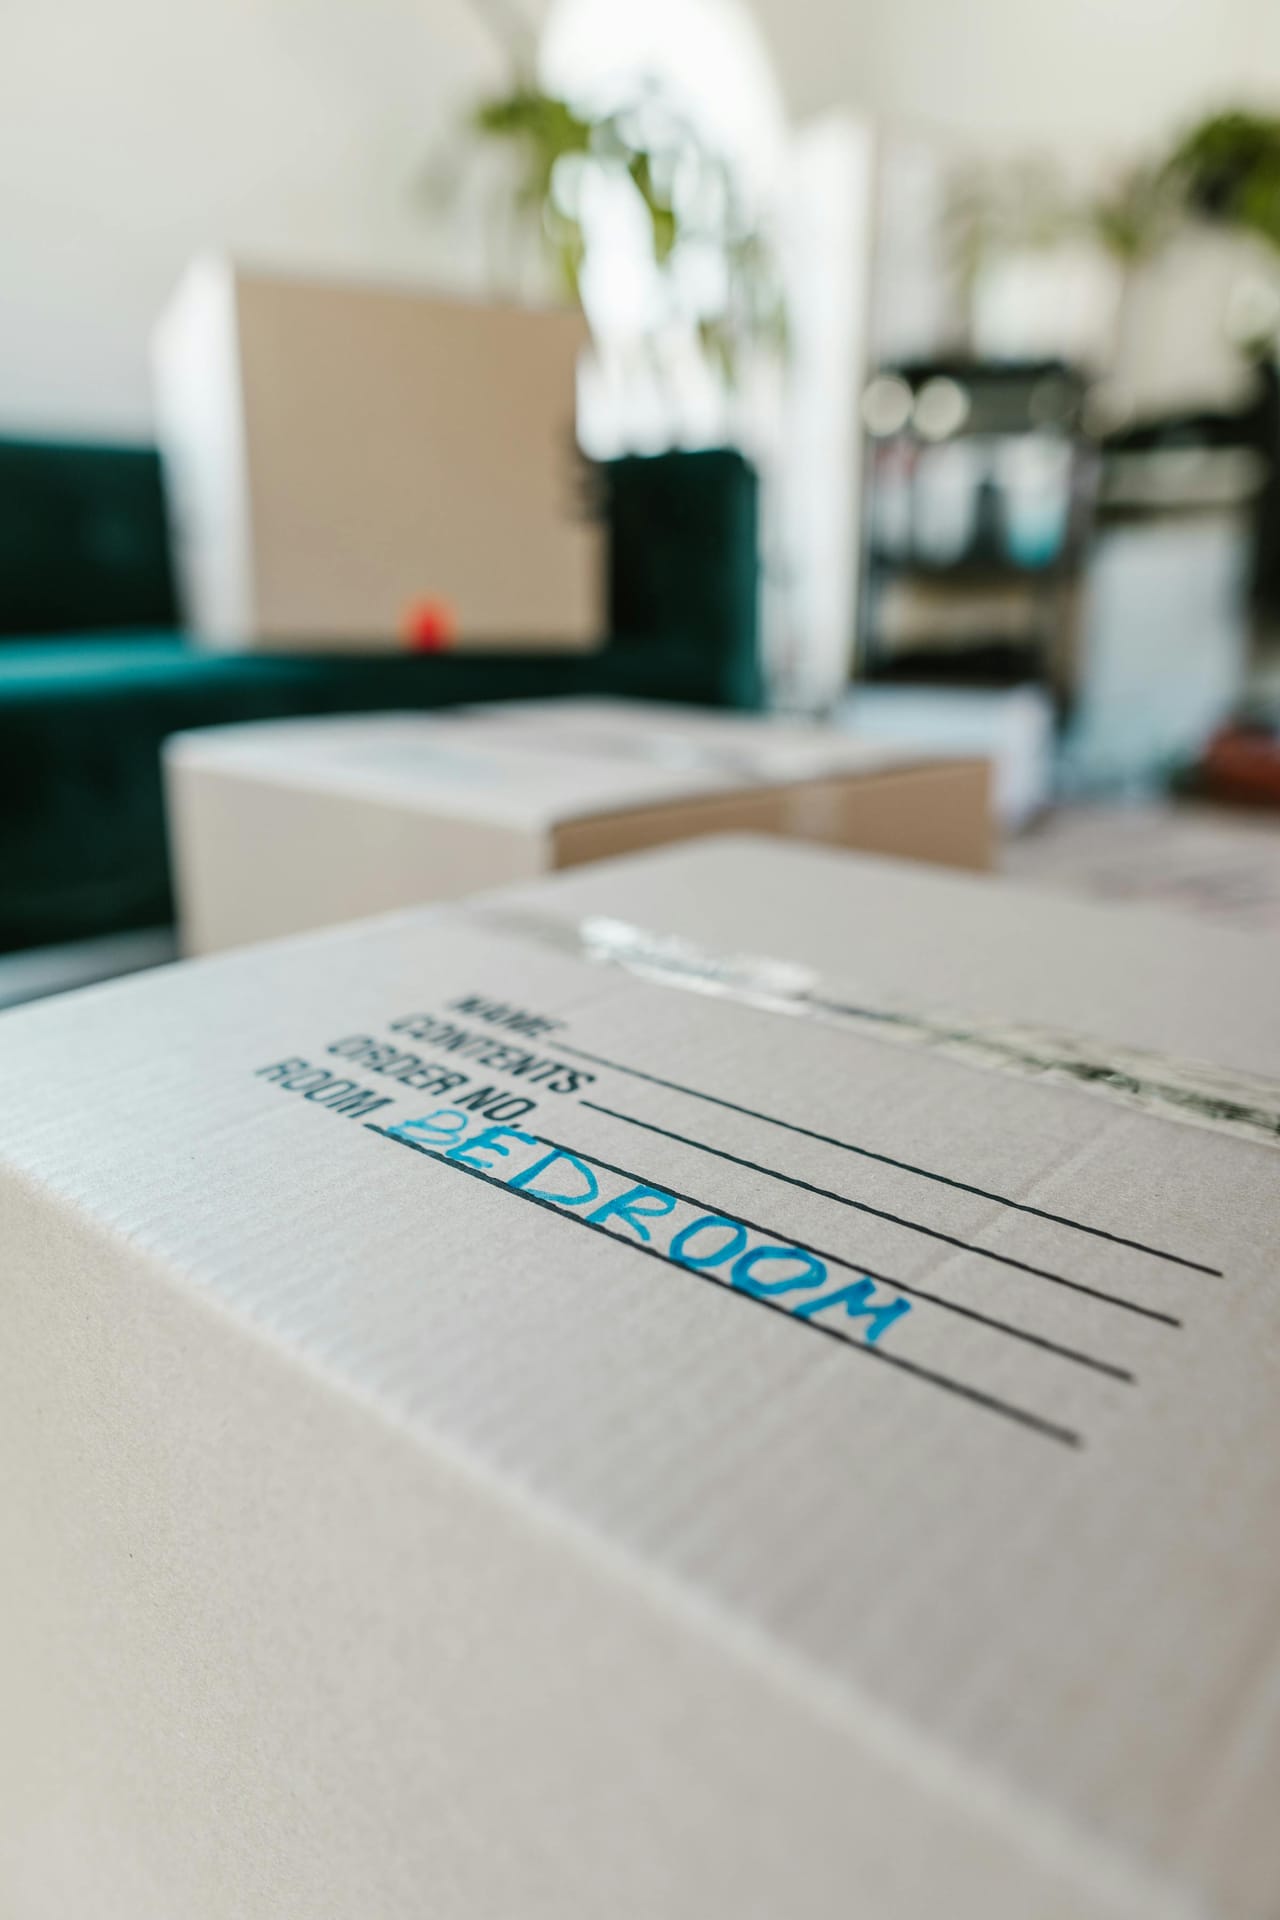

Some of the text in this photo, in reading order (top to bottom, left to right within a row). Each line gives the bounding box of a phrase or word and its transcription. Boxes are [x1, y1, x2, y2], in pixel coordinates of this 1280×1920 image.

[254, 1057, 396, 1119] ROOM
[326, 1034, 470, 1096] ORDER
[389, 1012, 596, 1094] CONTENTS
[387, 1109, 912, 1346] BEDROOM
